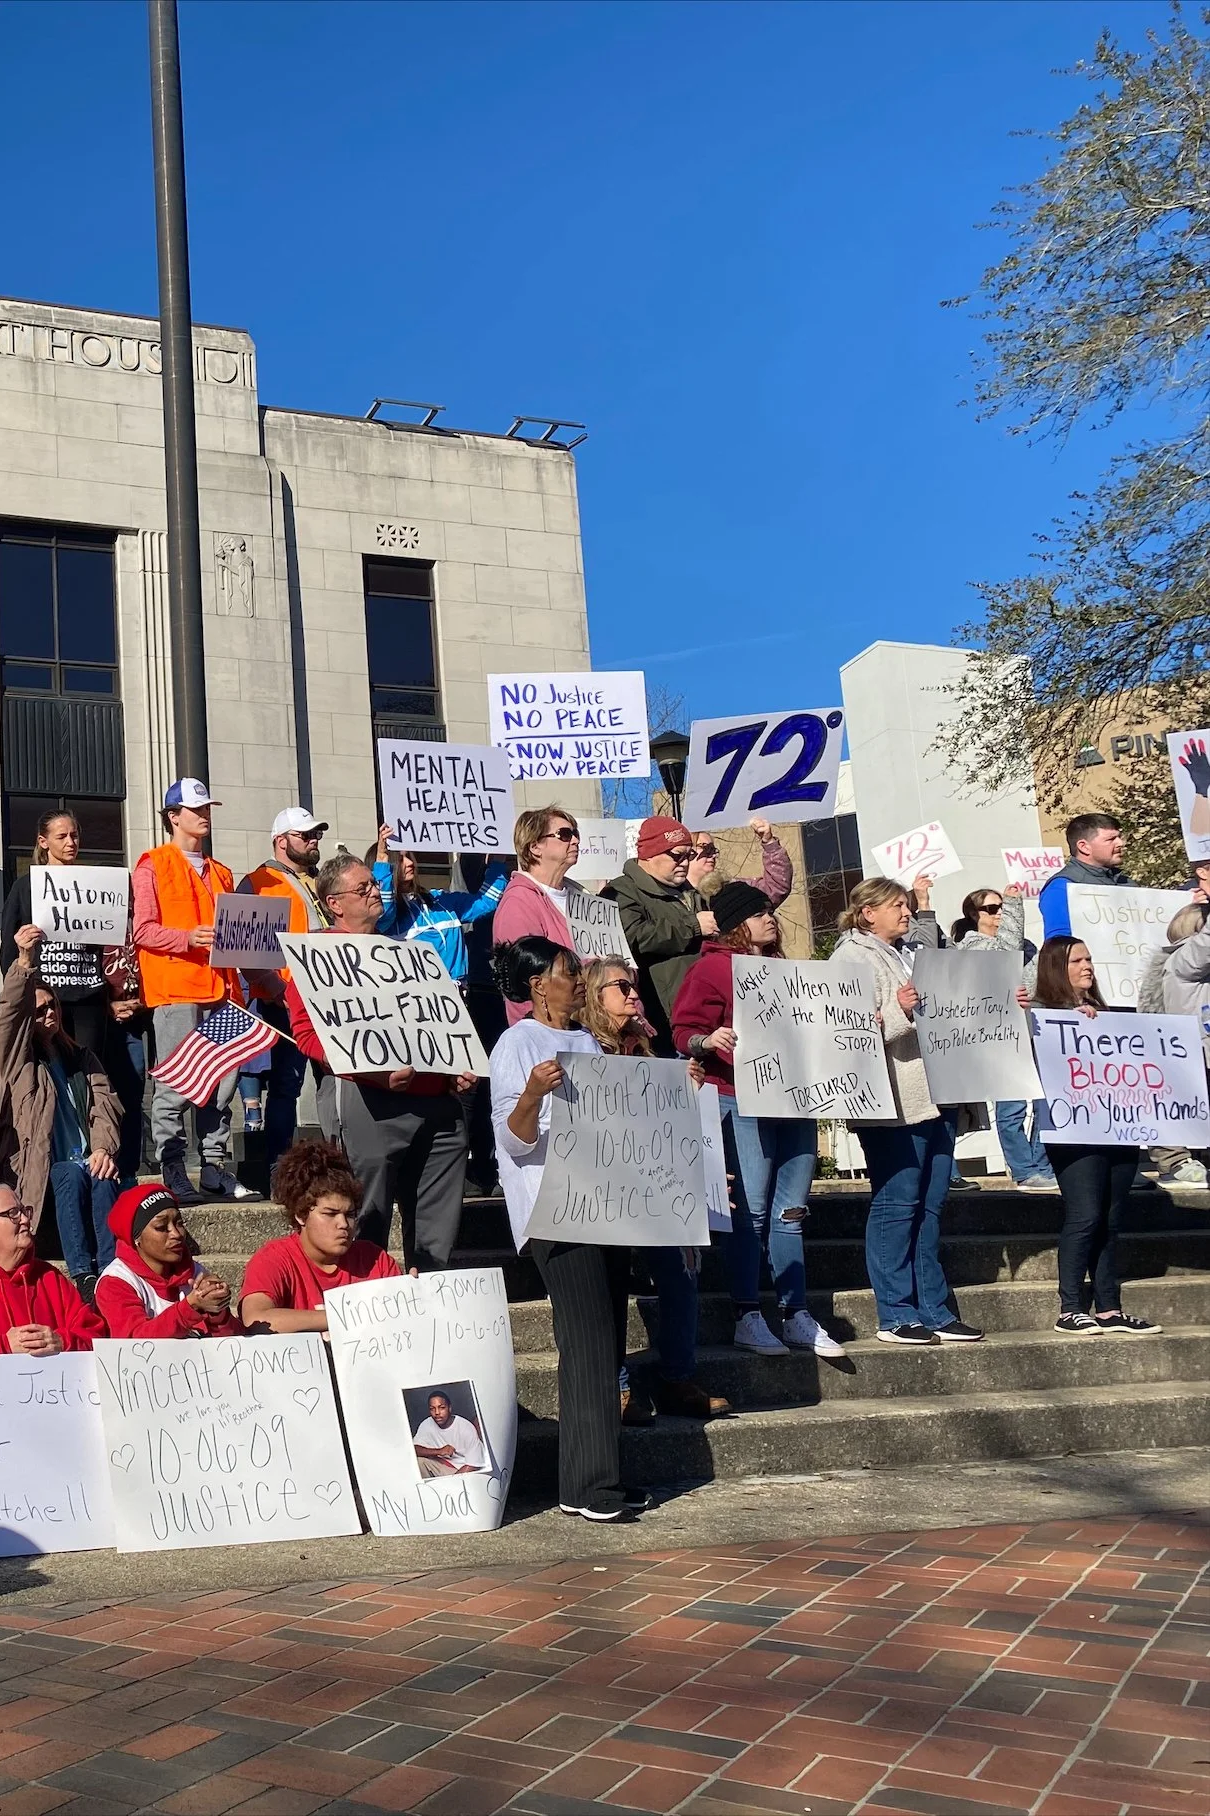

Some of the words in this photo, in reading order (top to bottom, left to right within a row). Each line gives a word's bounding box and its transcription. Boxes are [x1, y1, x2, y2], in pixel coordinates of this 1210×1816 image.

[44, 326, 164, 375] HOUS
[500, 683, 537, 706] NO
[503, 709, 542, 730] NO
[555, 707, 624, 730] PEACE
[570, 739, 643, 760] JUSTICE
[1110, 730, 1169, 762] PIN
[391, 751, 507, 794] MENTAL
[575, 758, 638, 776] PEACE
[406, 786, 497, 822] HEALTH
[394, 817, 499, 849] MATTERS
[1004, 850, 1063, 869] Murder
[51, 906, 115, 933] Harris
[567, 891, 619, 928] VINCENT
[1079, 893, 1170, 925] Justice
[1113, 930, 1149, 956] for
[40, 962, 67, 973] side
[286, 942, 380, 992] YOUR
[371, 944, 442, 984] SINS
[736, 964, 771, 1000] Justice
[783, 966, 831, 1000] When
[1093, 961, 1142, 999] To
[309, 995, 393, 1028] WILL
[395, 992, 460, 1024] FIND
[754, 988, 785, 1028] Tony!
[791, 1006, 815, 1026] the
[825, 1004, 878, 1031] MURDER
[330, 1026, 413, 1070] YOU
[417, 1028, 473, 1071] OUT
[1045, 1018, 1145, 1057] There
[1159, 1028, 1188, 1058] is
[743, 1052, 784, 1094] THEY
[1067, 1057, 1165, 1090] BLOOD
[561, 1064, 638, 1125] Vincent
[635, 1060, 699, 1119] Rowell
[784, 1072, 859, 1112] TORTURED
[843, 1081, 882, 1120] HIM!
[1049, 1097, 1091, 1129] On
[1153, 1093, 1208, 1121] hands
[594, 1121, 675, 1169] 10-06-09
[552, 1174, 663, 1226] Justice
[328, 1286, 427, 1332] Vincent
[429, 1271, 503, 1310] Rowell
[343, 1330, 413, 1366] 7-21-88
[17, 1369, 101, 1407] Justic
[97, 1347, 223, 1418] Vincent
[217, 1338, 325, 1403] Rowell
[146, 1414, 293, 1485] 10-06-09
[149, 1478, 311, 1541] Justice
[371, 1489, 411, 1534] My
[415, 1478, 479, 1524] Dad
